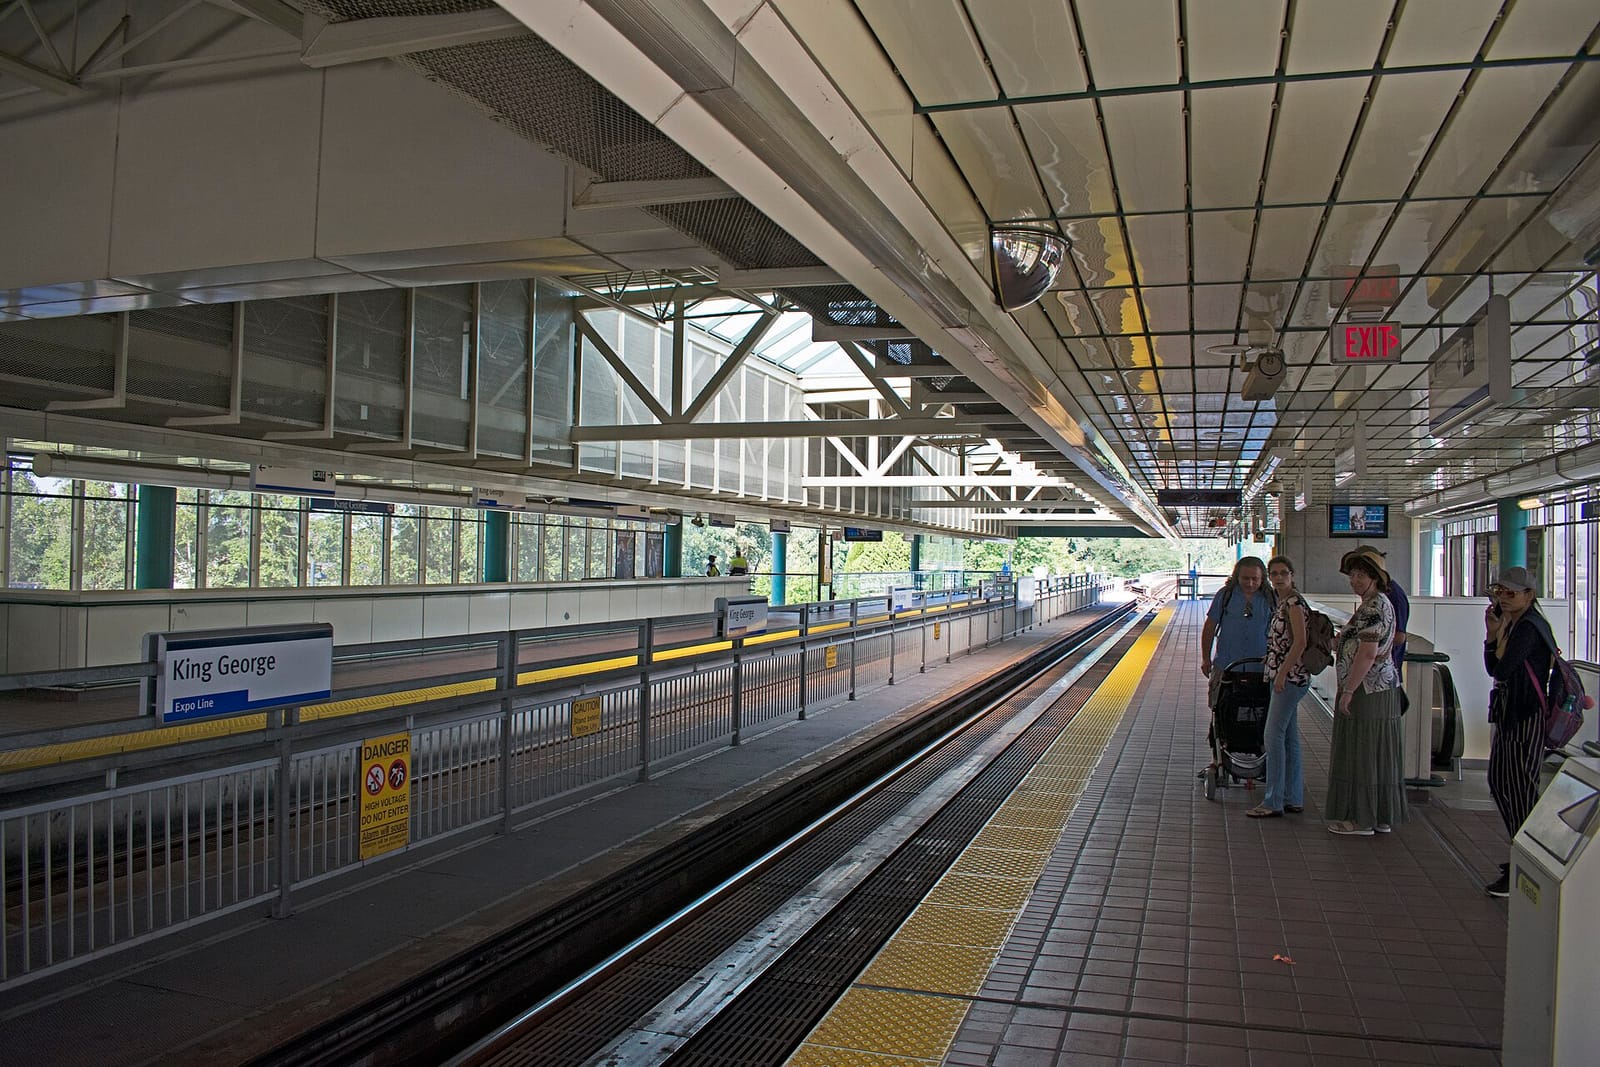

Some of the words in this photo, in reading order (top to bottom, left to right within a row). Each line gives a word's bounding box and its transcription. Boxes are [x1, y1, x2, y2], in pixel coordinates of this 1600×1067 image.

[1346, 326, 1392, 358] EXIT
[334, 500, 347, 511] King
[348, 501, 368, 511] George
[730, 609, 740, 622] King
[740, 608, 755, 621] George
[173, 658, 213, 682] King
[218, 655, 276, 676] George
[175, 701, 195, 713] Expo
[197, 698, 214, 709] Line
[574, 699, 600, 714] CAUTION
[364, 739, 409, 761] DANGER
[365, 800, 380, 812] HIGH
[380, 793, 407, 808] VOLTAGE
[361, 815, 371, 826] DO
[373, 811, 387, 822] NOT
[388, 804, 409, 818] ENTER
